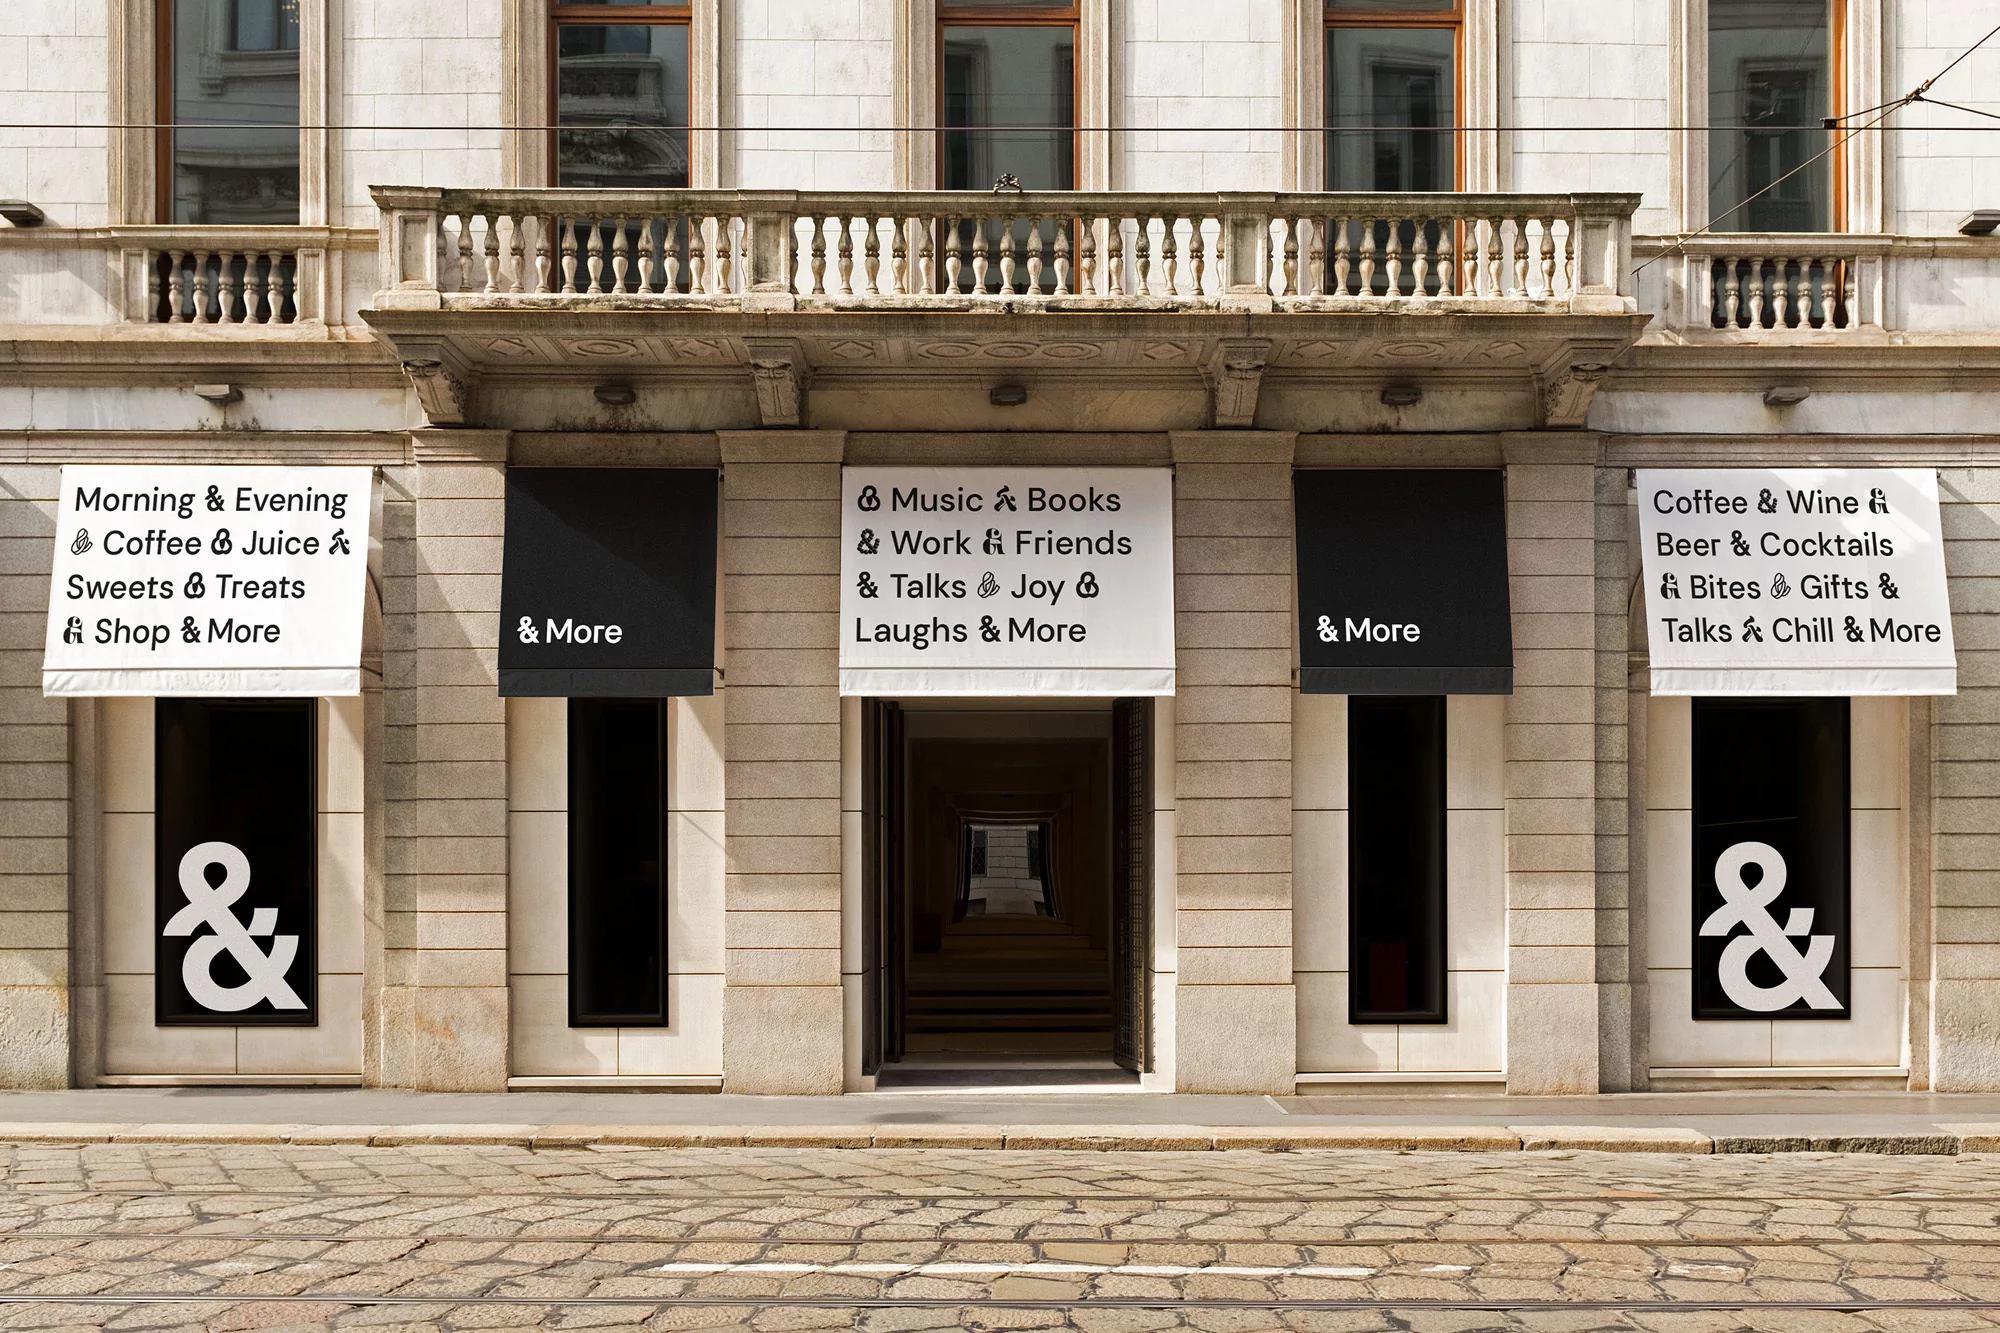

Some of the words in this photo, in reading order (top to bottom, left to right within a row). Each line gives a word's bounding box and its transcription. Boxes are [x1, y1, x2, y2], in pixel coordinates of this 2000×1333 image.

[76, 487, 195, 519] Morning
[236, 487, 348, 519] Evening
[892, 487, 983, 512] Music
[1029, 486, 1121, 512] Books
[1654, 490, 1747, 514] Coffee
[1786, 490, 1858, 514] Wine
[104, 530, 201, 555] Coffee
[242, 530, 319, 555] Juice
[891, 530, 972, 555] Work
[1017, 530, 1132, 555] Friends
[1657, 533, 1720, 556] Beer
[1761, 532, 1893, 556] Cocktails
[67, 574, 173, 599] Sweets
[216, 575, 305, 598] Treats
[890, 573, 966, 598] Talks
[1011, 574, 1065, 605] Joy
[1691, 574, 1761, 599] Bites
[1801, 574, 1868, 599] Gifts
[95, 618, 170, 651] Shop
[208, 618, 280, 643] More
[546, 619, 622, 643] More
[857, 617, 967, 650] Laughs
[1009, 618, 1086, 642] More
[1346, 618, 1420, 642] More
[1662, 617, 1732, 642] Talks
[1773, 617, 1833, 642] Chill
[1870, 618, 1940, 642] More
[163, 842, 308, 1011] &
[1699, 842, 1844, 1011] &
